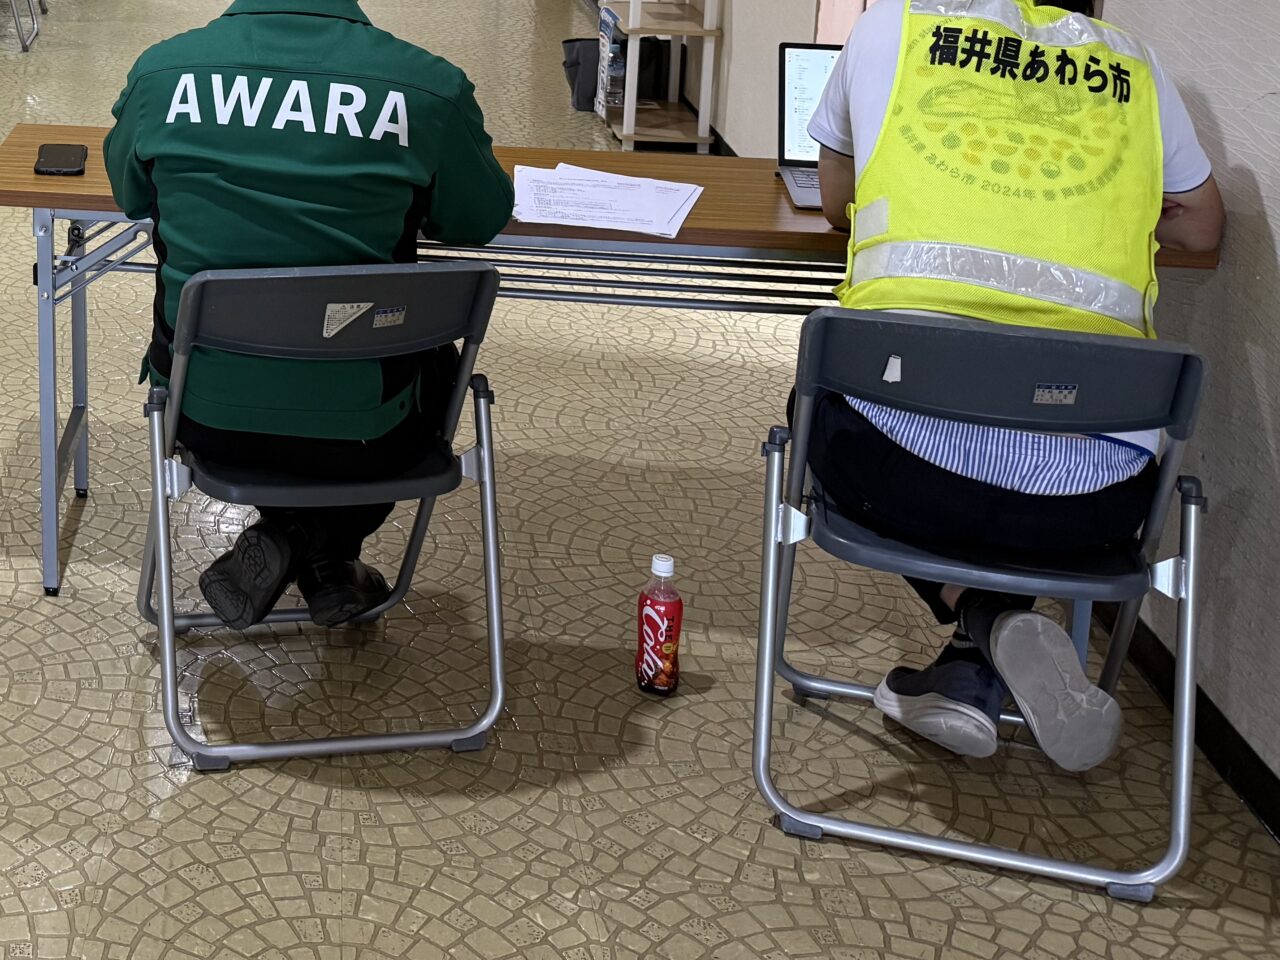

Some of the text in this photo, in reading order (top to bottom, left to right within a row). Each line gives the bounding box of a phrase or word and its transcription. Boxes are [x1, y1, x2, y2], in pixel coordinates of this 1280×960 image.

[928, 25, 1131, 104] 福井県あわら市
[165, 73, 409, 147] AWARA
[980, 179, 1037, 201] 2024年
[641, 605, 668, 681] Cola
